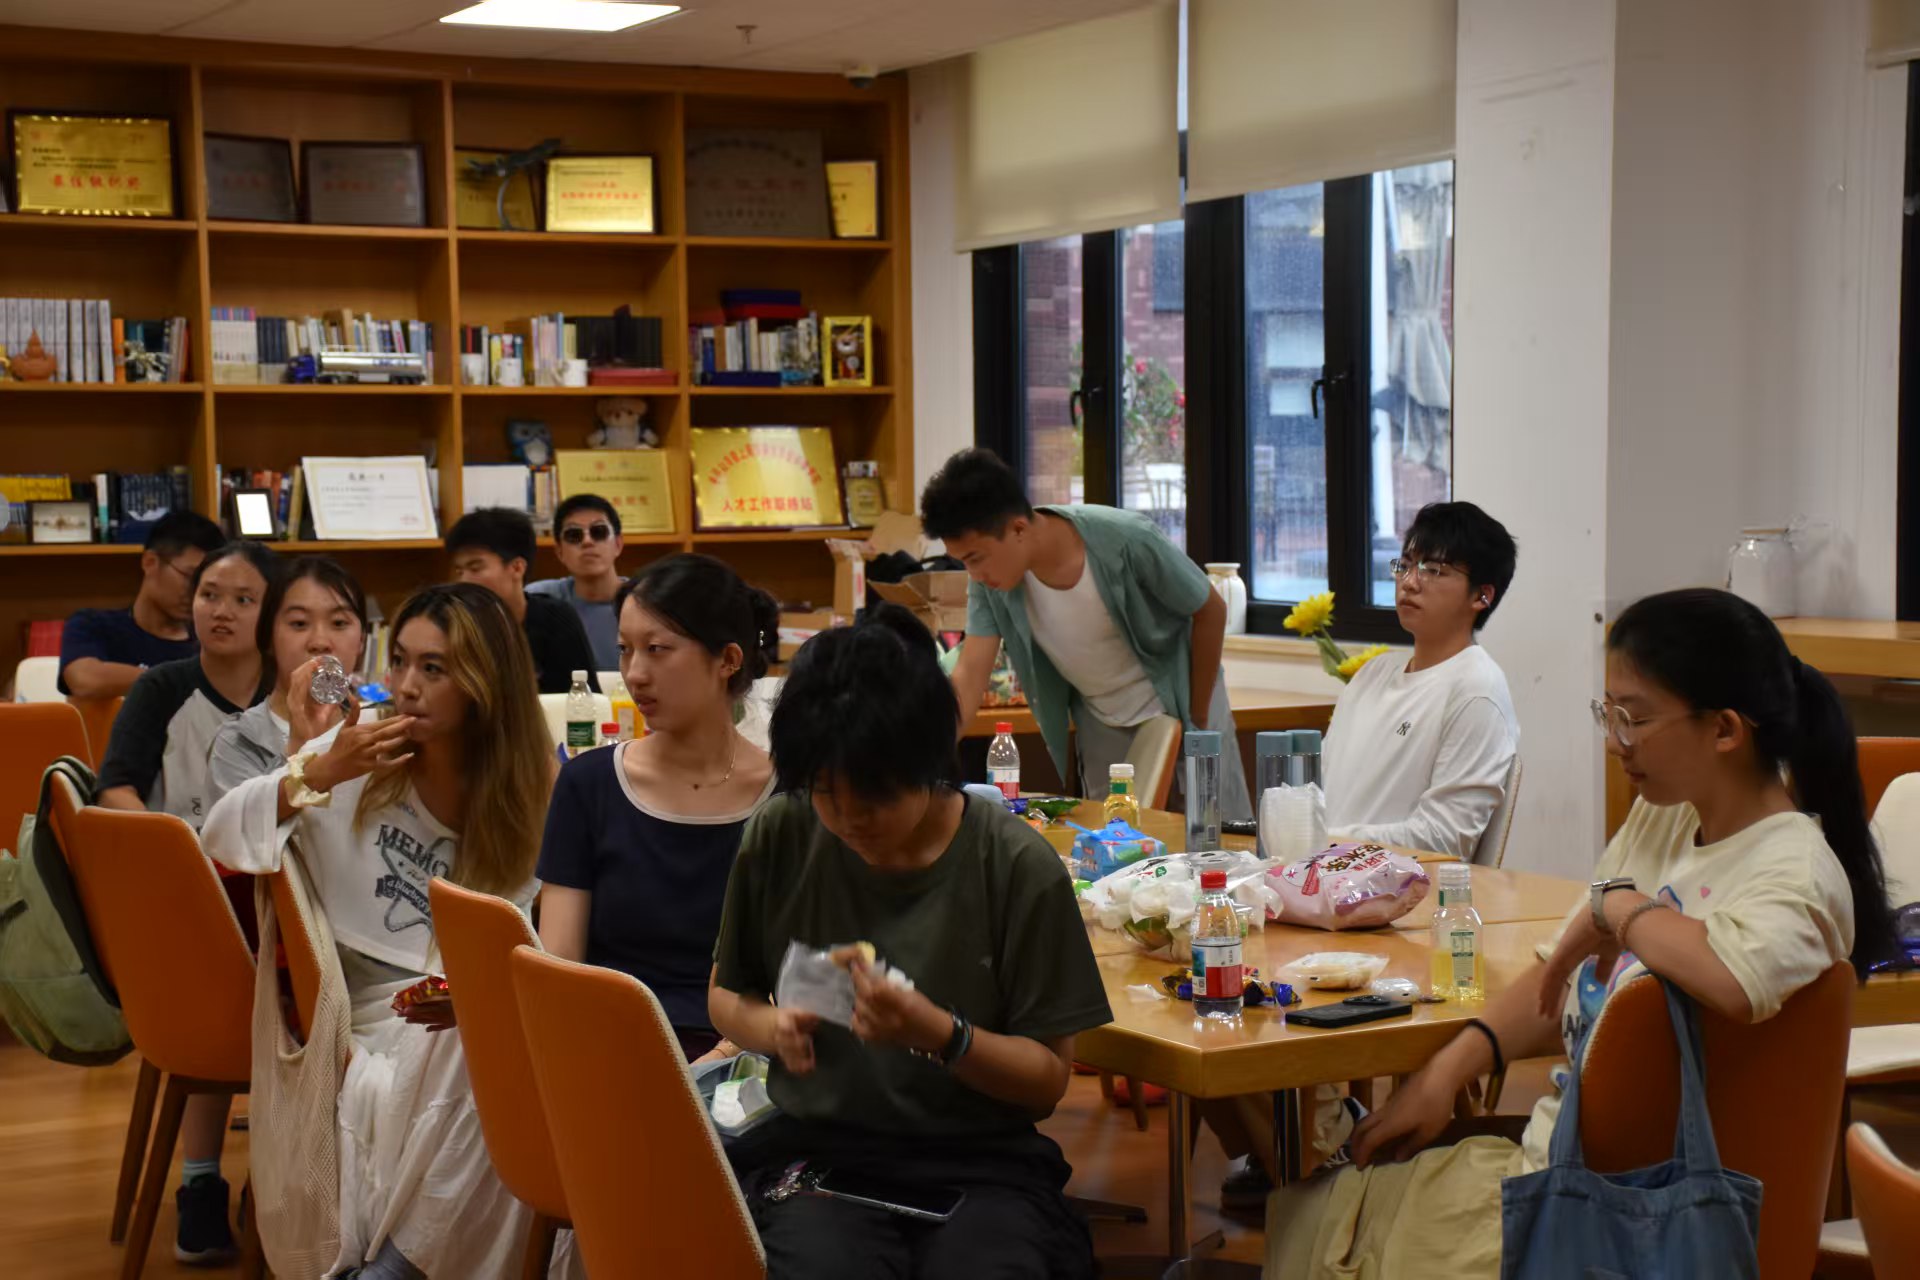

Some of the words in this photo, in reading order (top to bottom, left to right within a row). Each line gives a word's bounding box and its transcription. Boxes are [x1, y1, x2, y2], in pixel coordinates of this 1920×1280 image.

[722, 497, 813, 512] 人才工作联络站
